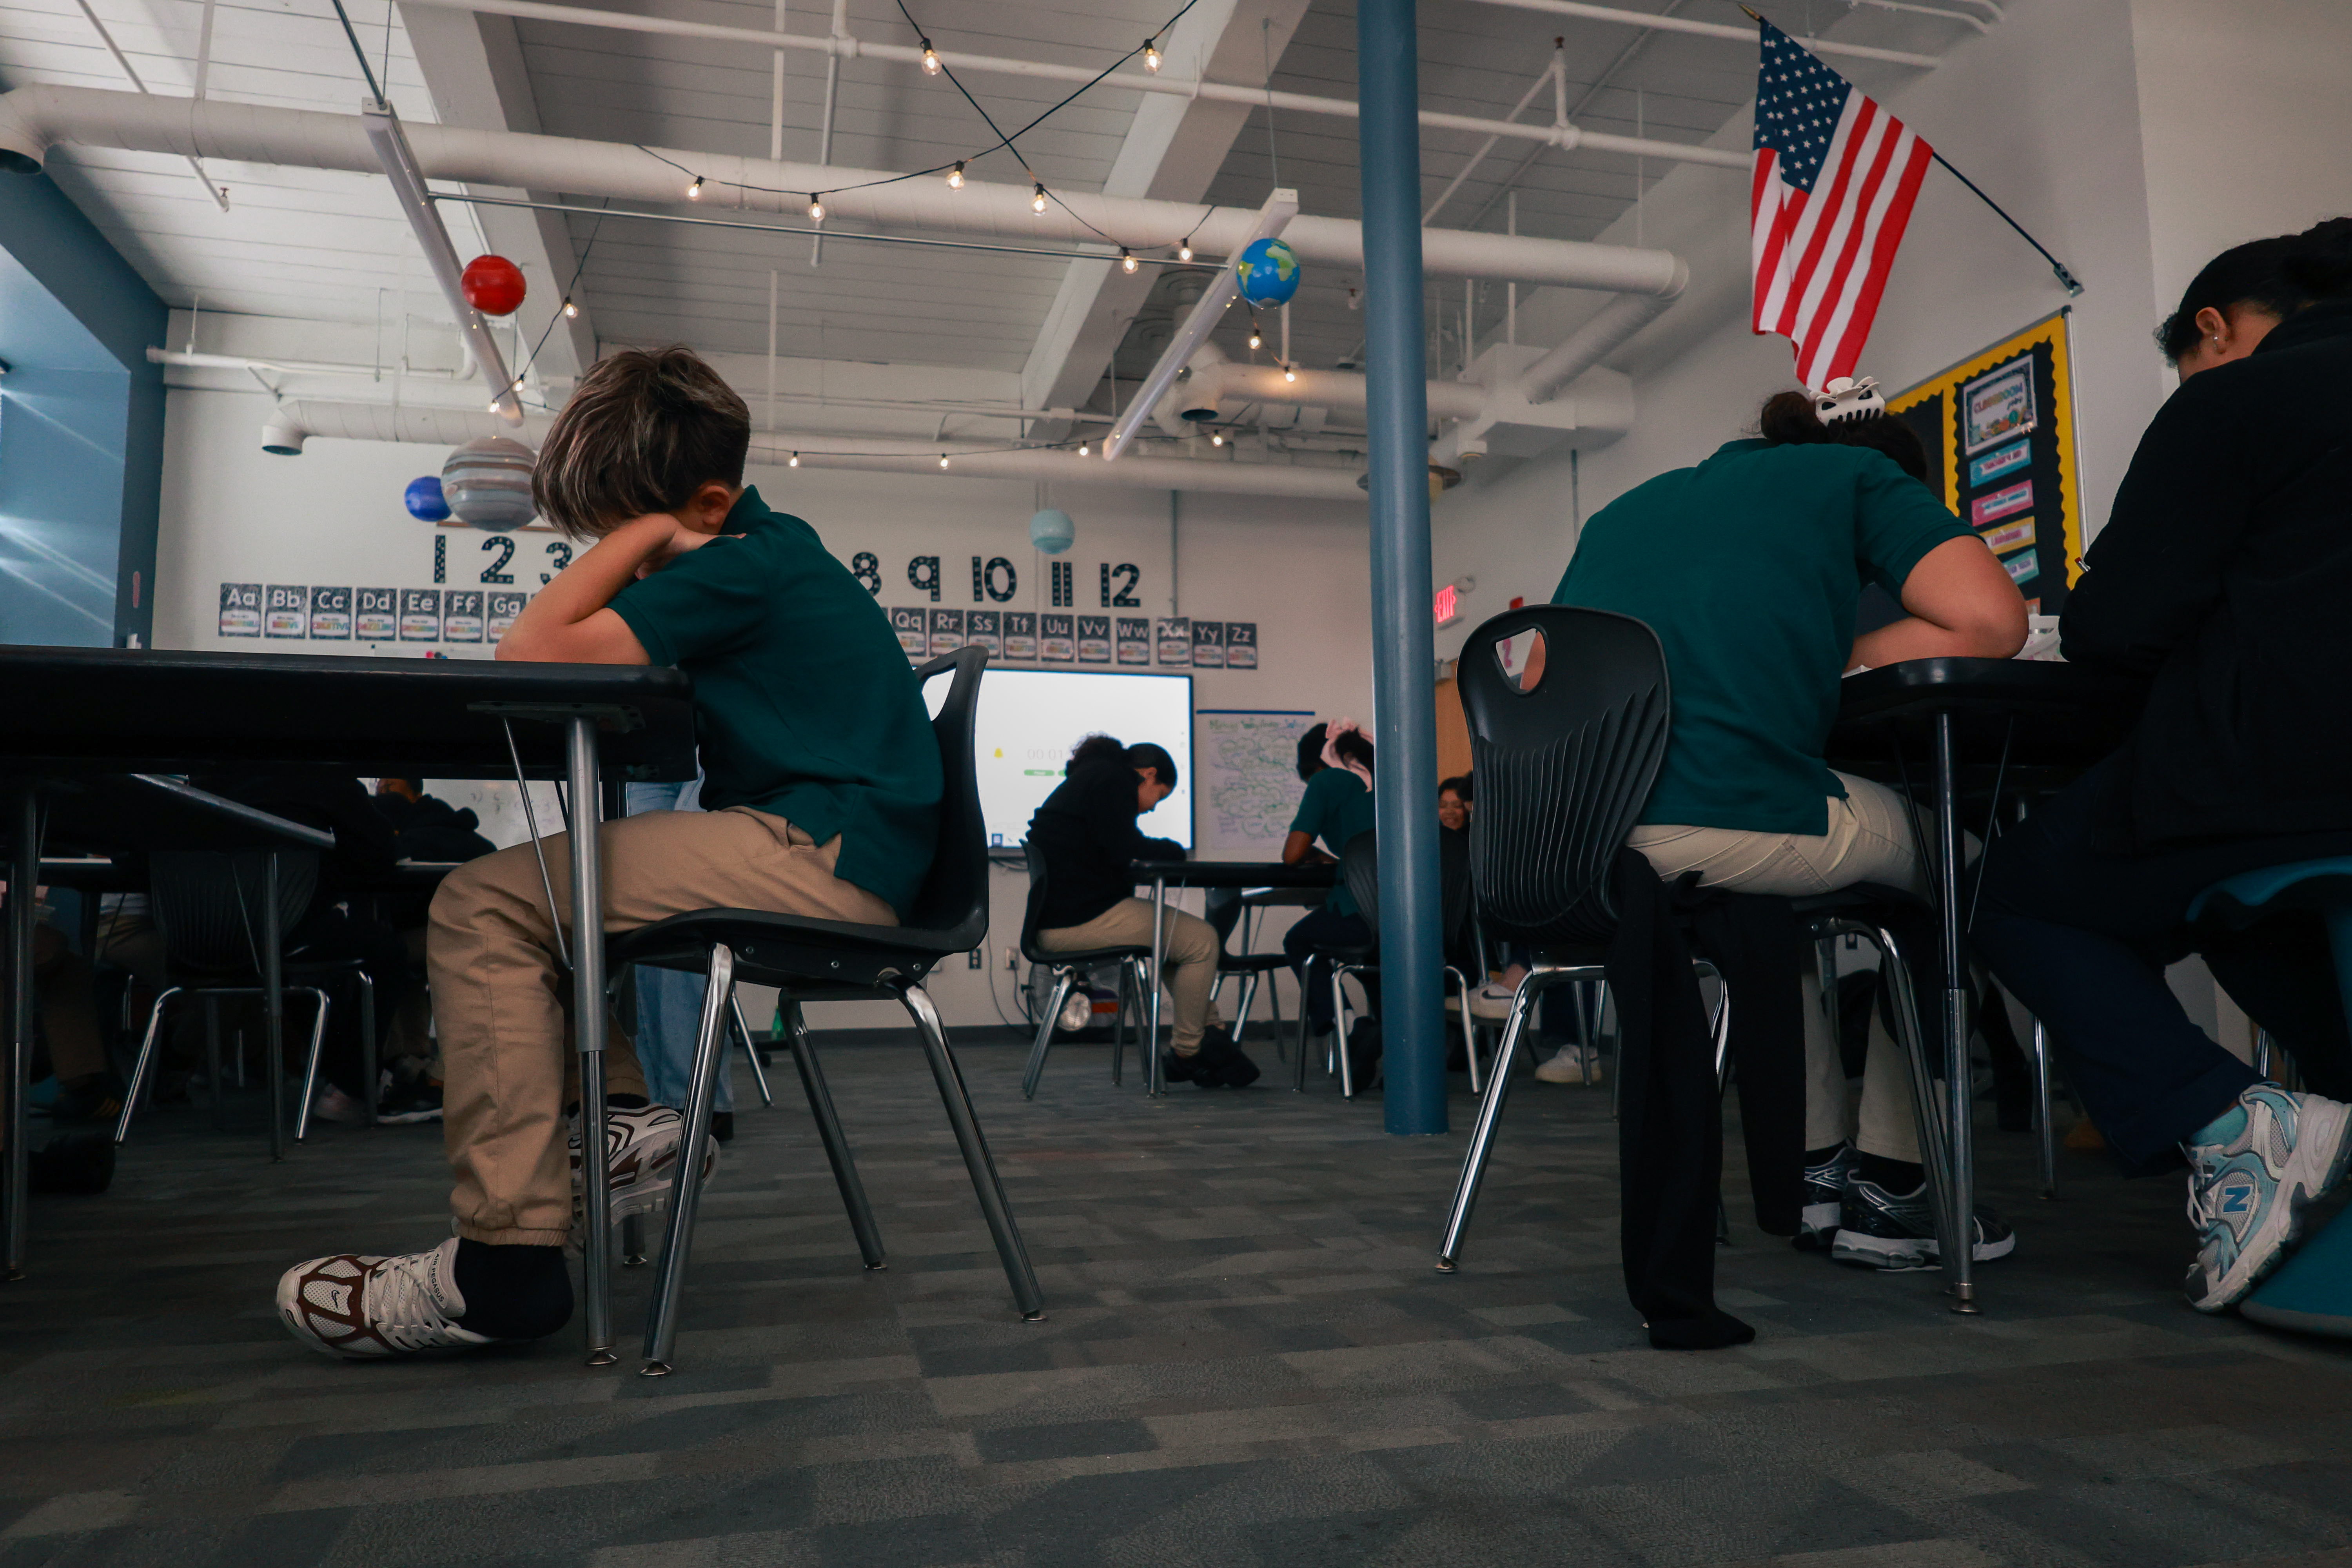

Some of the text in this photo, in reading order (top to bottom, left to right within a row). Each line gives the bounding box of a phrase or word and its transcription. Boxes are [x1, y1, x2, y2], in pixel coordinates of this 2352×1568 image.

[434, 535, 1140, 608] 1 2 3 8 9 10 11 12
[227, 588, 255, 606] Aa
[274, 590, 300, 608] Bb
[318, 592, 344, 608] Cc
[363, 592, 390, 610] Dd
[408, 593, 434, 612] Ee
[453, 595, 476, 612] Ff
[494, 597, 521, 617] Gg
[896, 612, 922, 632] Qq
[937, 613, 958, 629] Rr
[974, 615, 993, 632] Ss
[1011, 617, 1028, 632] Tt
[1047, 619, 1068, 634] Uu
[1082, 621, 1105, 635] Vv
[1118, 622, 1149, 637] Ww
[1198, 626, 1218, 644] Yy
[1232, 627, 1251, 642] Zz
[431, 1268, 445, 1302] PEGASUS
